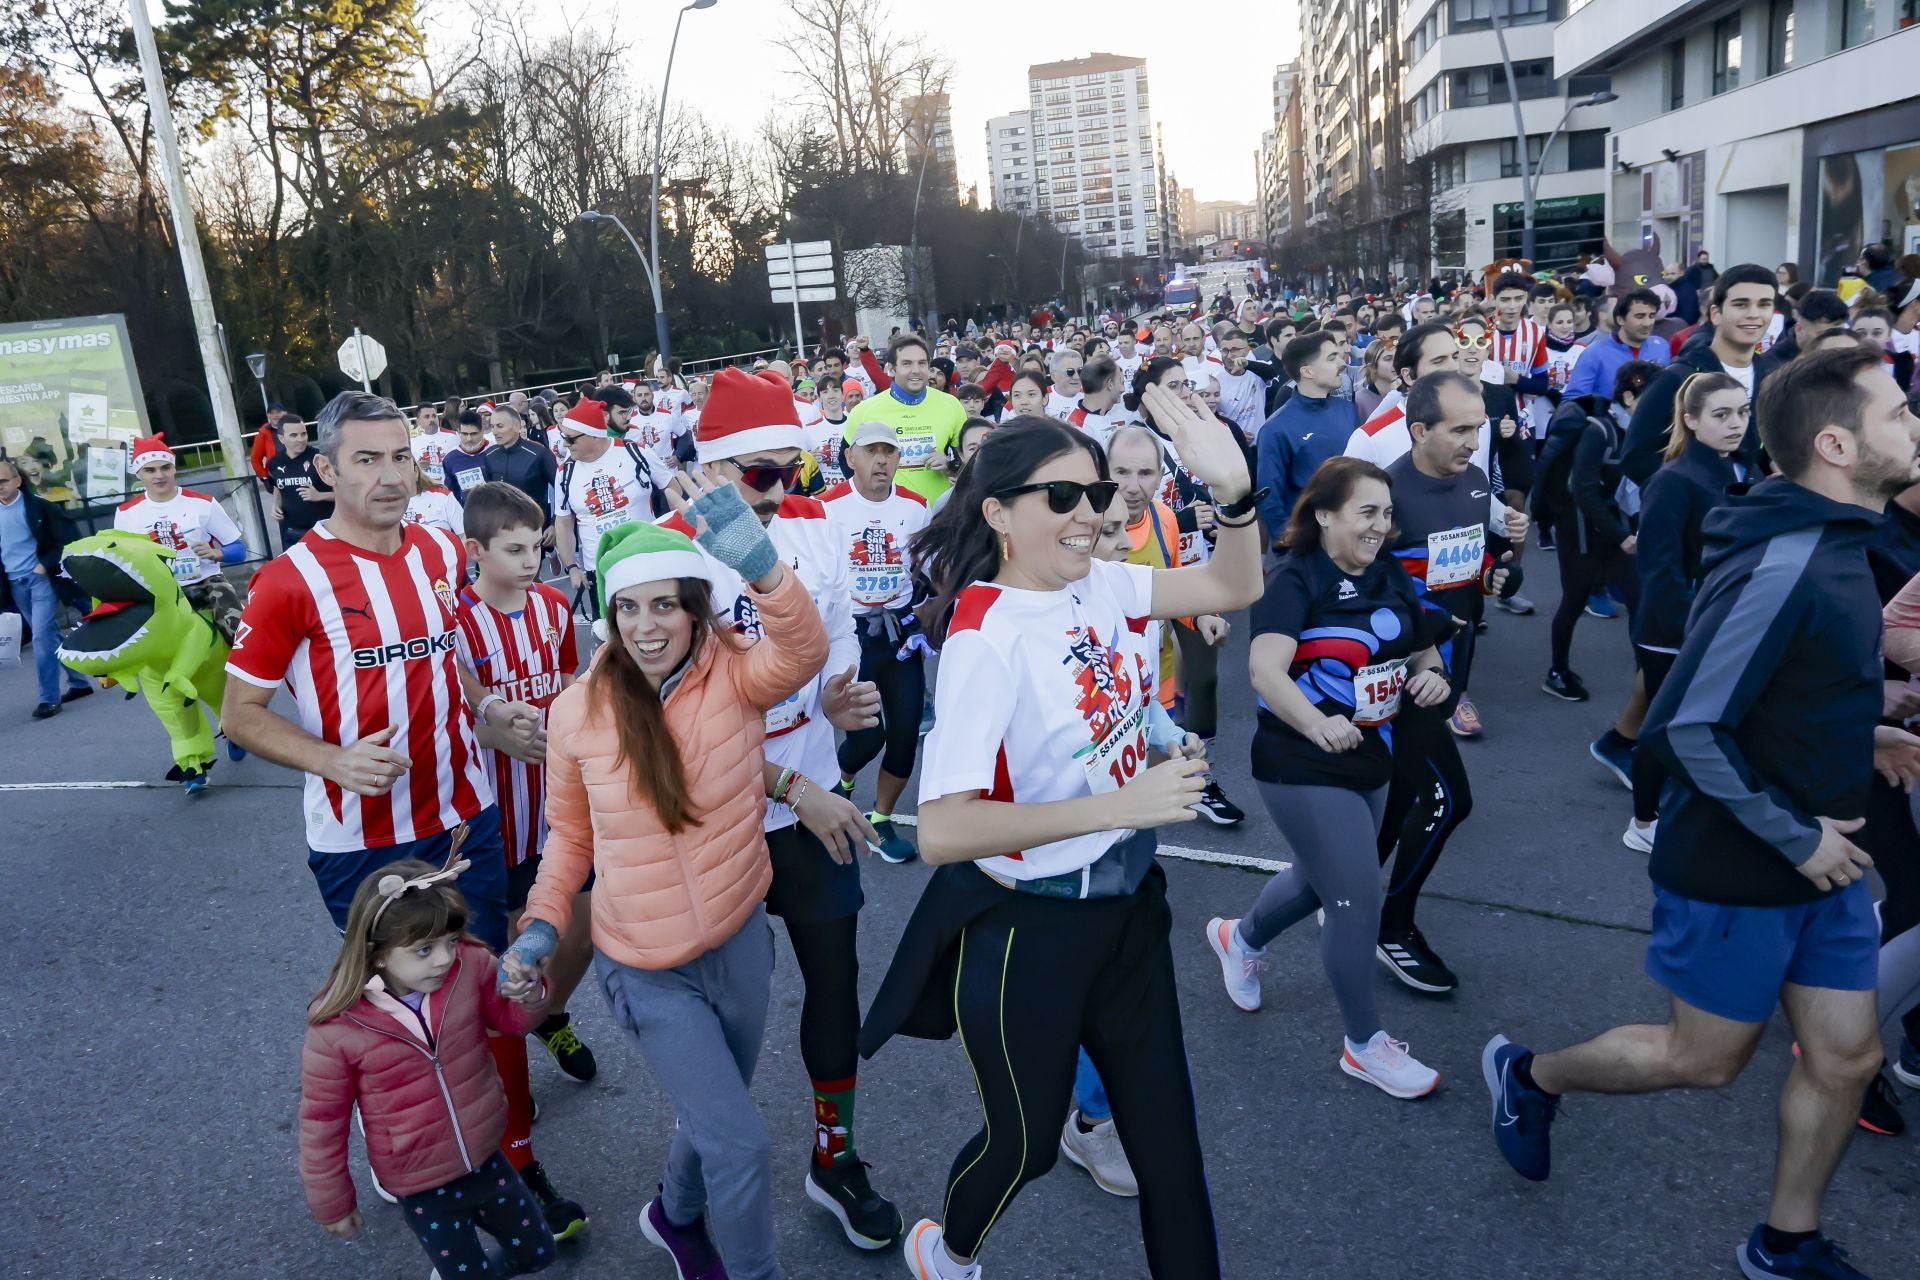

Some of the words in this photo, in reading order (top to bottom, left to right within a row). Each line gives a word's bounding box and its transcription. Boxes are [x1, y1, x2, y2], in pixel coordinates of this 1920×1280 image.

[0, 382, 45, 394] ESCARGA
[597, 487, 612, 497] SIL
[599, 494, 614, 503] VES
[873, 529, 886, 538] 55
[1449, 532, 1460, 541] SAN
[866, 535, 886, 544] SAN
[867, 544, 886, 554] SIL
[1435, 541, 1480, 567] 4466
[868, 553, 887, 563] VES
[855, 576, 899, 592] 3781
[1364, 670, 1404, 705] 1545
[1099, 743, 1110, 758] 55
[1109, 728, 1124, 749] SAN
